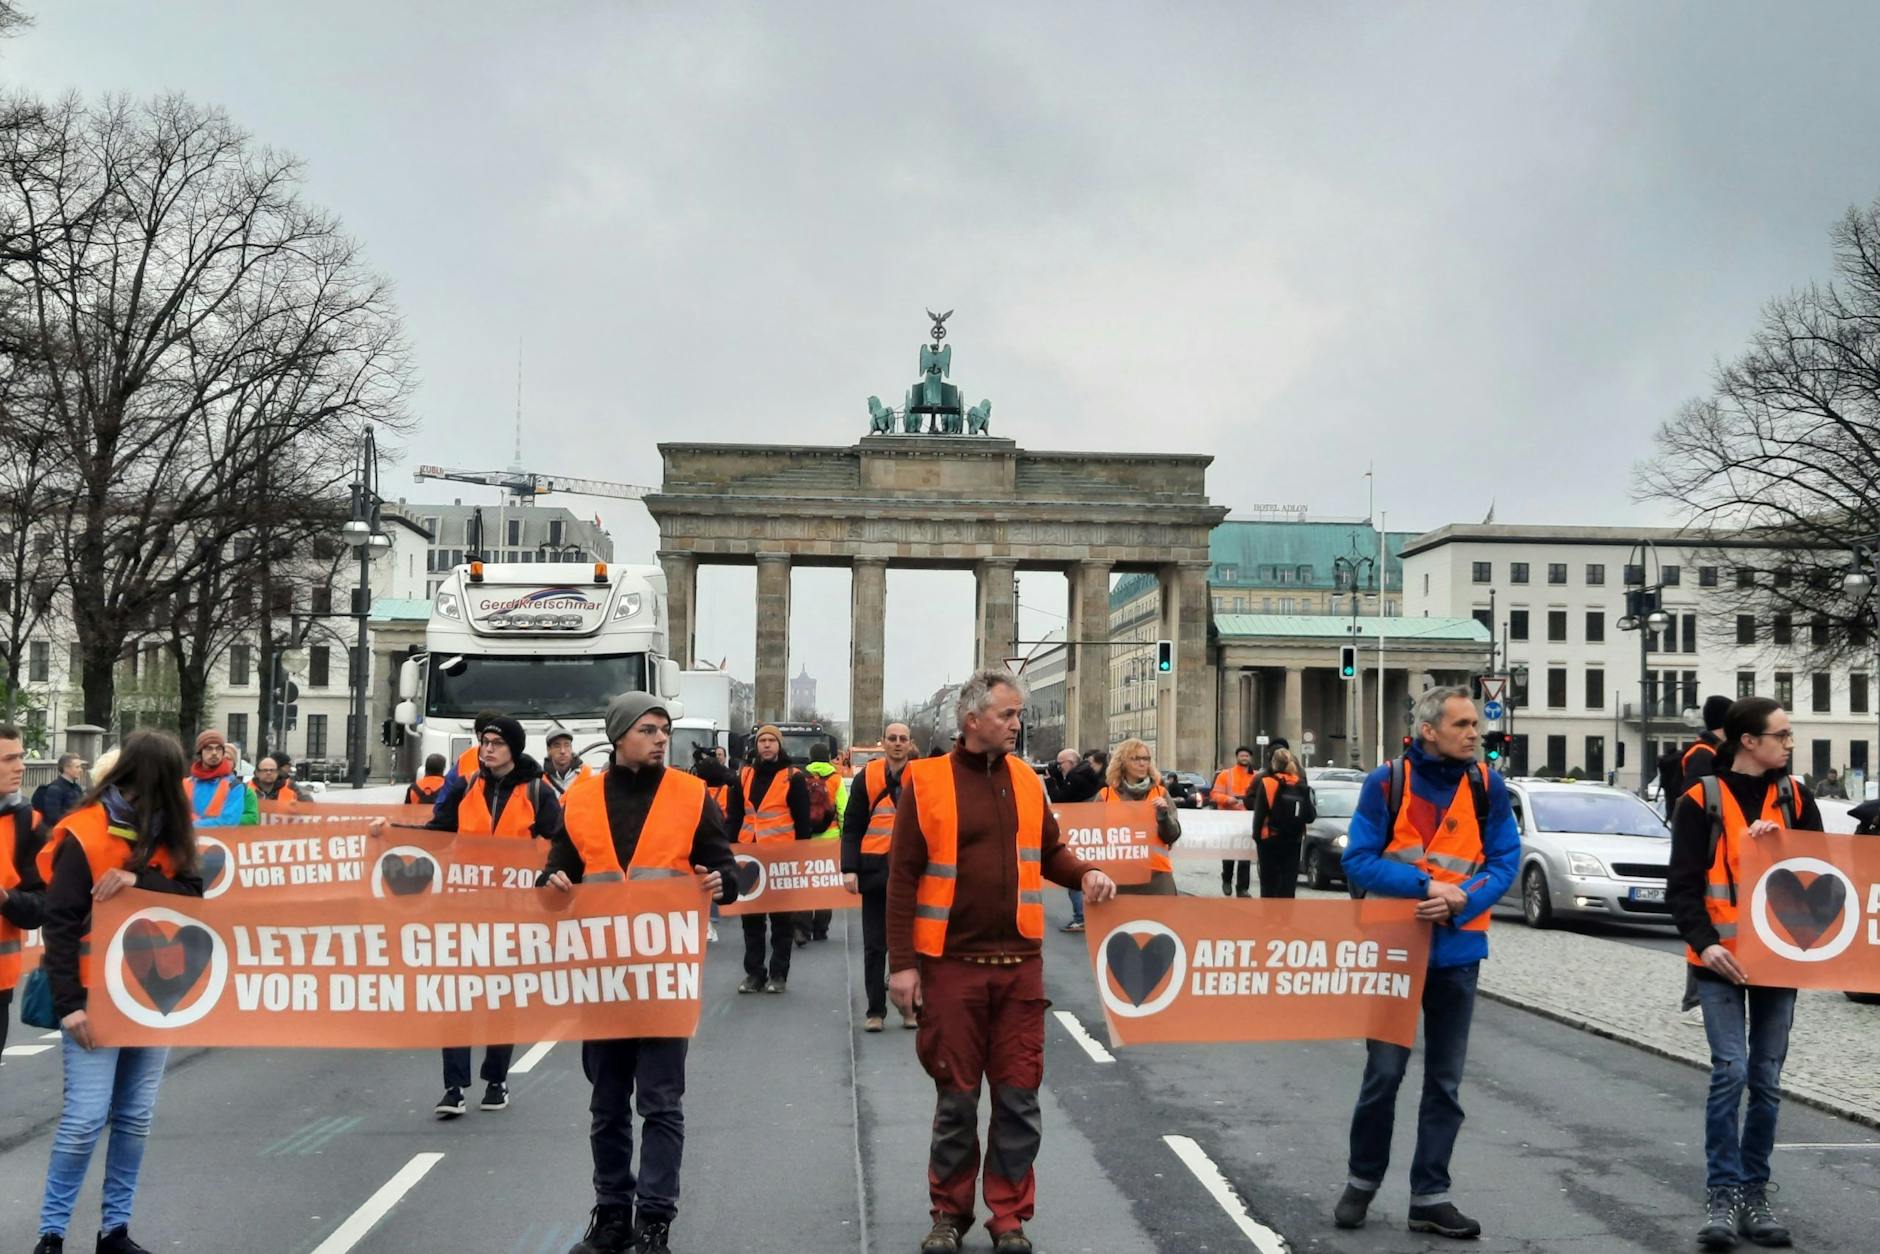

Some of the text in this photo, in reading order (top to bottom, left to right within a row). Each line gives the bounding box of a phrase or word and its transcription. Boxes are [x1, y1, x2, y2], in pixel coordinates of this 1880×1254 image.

[1281, 504, 1308, 512] ADLON
[480, 599, 602, 611] Gerd Kretschmar
[1068, 828, 1103, 845] 20A
[1107, 827, 1131, 844] GG
[238, 838, 322, 865] LETZTE
[1075, 843, 1149, 861] SCHÜTZEN
[239, 861, 364, 888] VOR DEN KI
[447, 864, 497, 886] ART.
[769, 859, 836, 877] ART. 20A
[769, 875, 808, 890] LEBEN
[233, 910, 699, 968] LETZTE GENERATION
[1192, 939, 1408, 968] ART. 20A GG =
[234, 962, 699, 1013] VOR DEN KIPPPUNKTEN
[1191, 967, 1411, 999] LEBEN SCHÜTZEN
